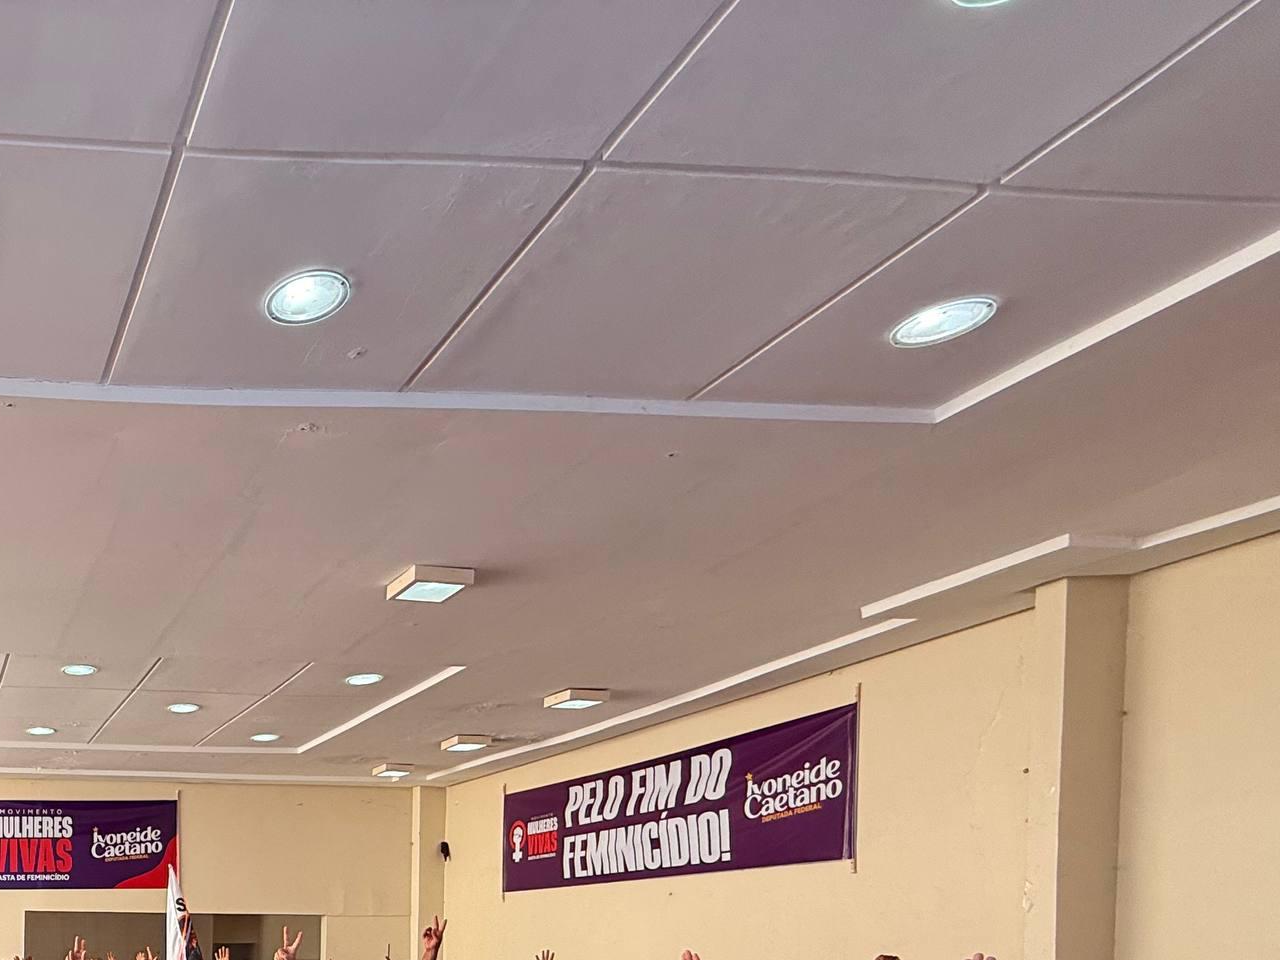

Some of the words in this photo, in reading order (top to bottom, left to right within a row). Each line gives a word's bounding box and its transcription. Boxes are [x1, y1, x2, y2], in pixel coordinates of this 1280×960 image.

[564, 774, 625, 828] PELO
[625, 759, 682, 817] FIM
[684, 748, 732, 805] DO
[743, 779, 843, 819] Caetano
[91, 841, 163, 859] Caetano
[528, 831, 558, 856] VIVAS
[562, 808, 731, 879] FEMINICÍDIO!
[26, 873, 70, 881] FEMINICÍDIO
